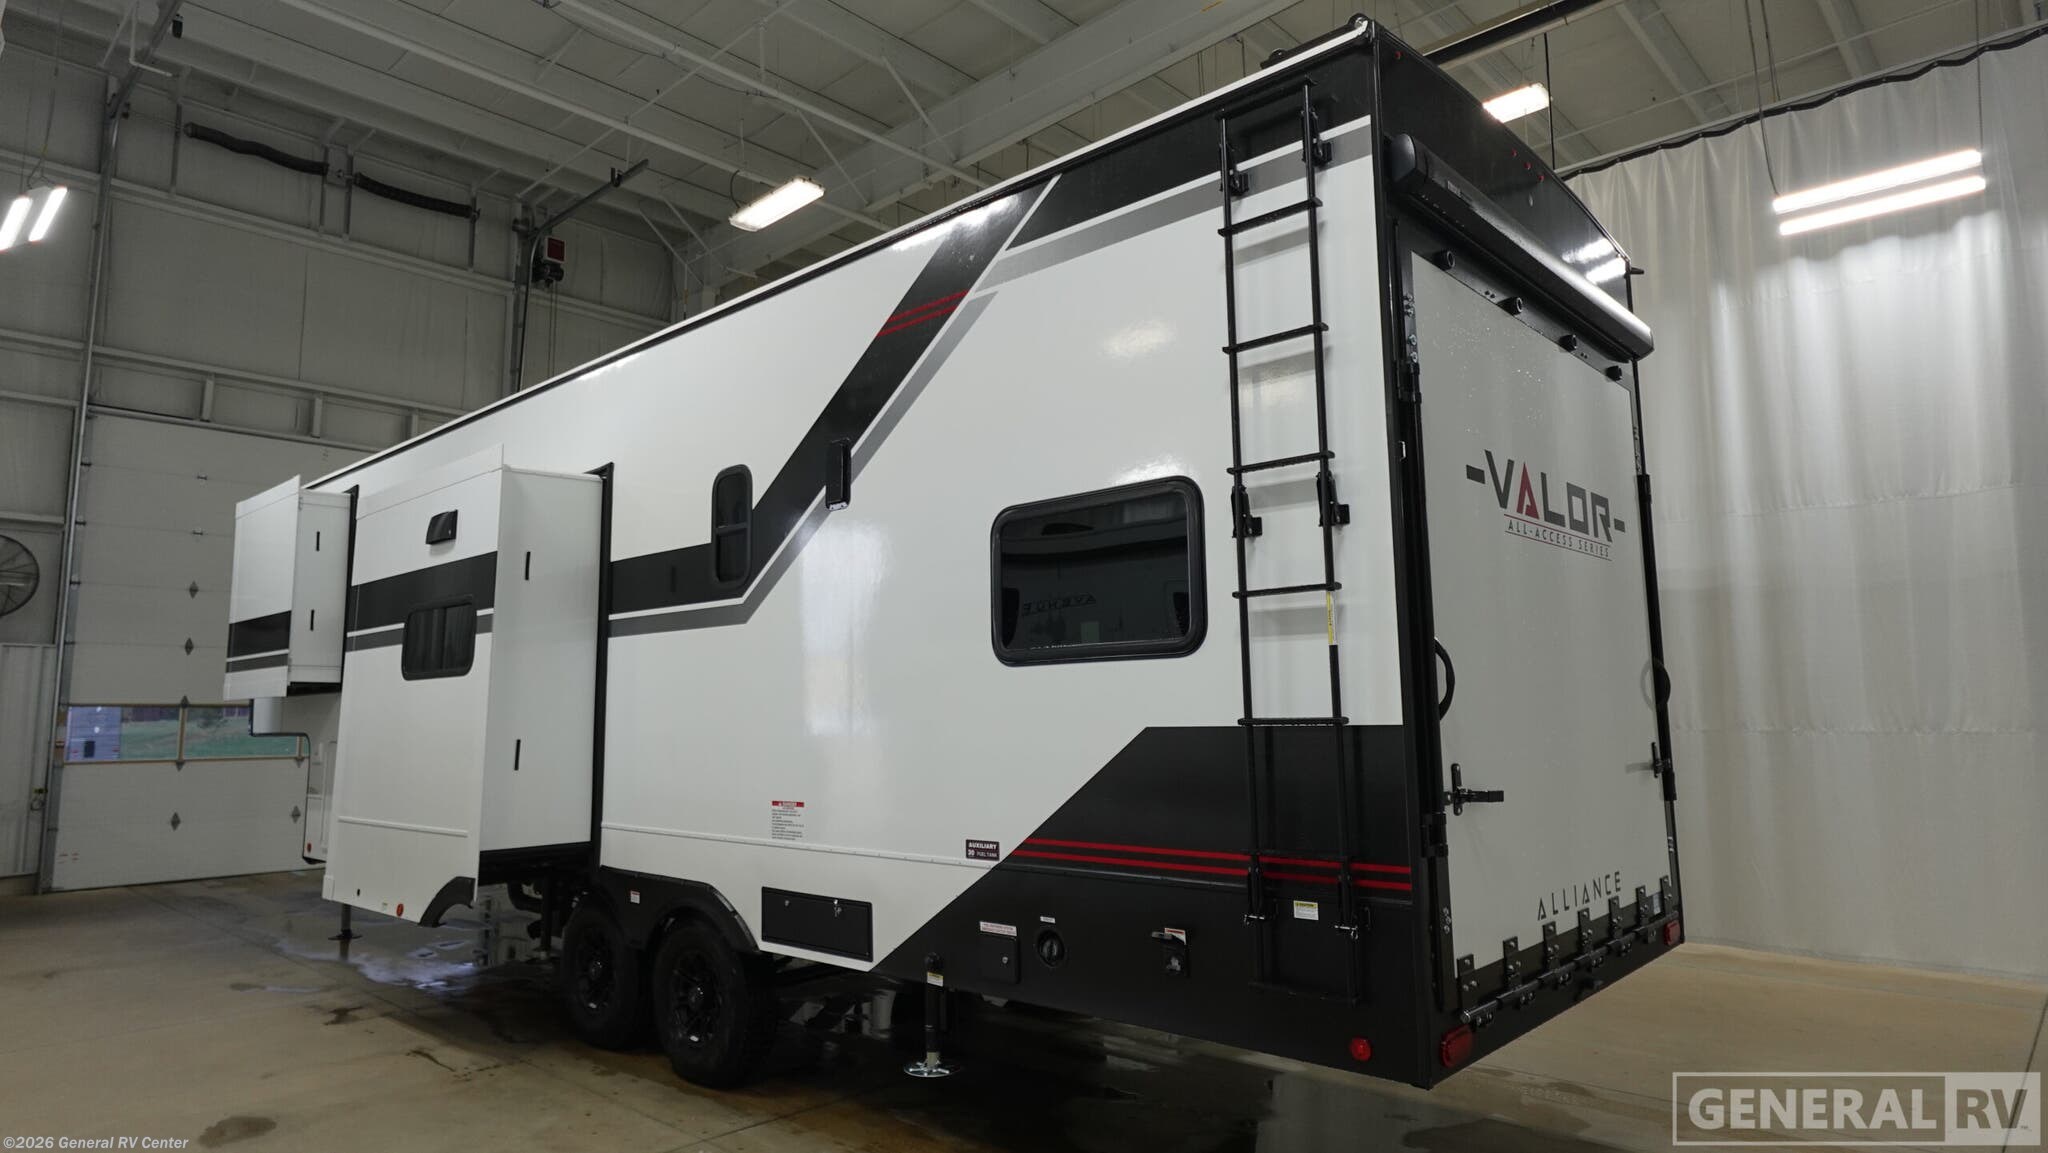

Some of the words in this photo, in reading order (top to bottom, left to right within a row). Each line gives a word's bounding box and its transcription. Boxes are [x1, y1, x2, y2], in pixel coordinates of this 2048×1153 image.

[1508, 519, 1573, 547] ALL-ACCESS
[1578, 539, 1609, 558] SERIES
[1537, 871, 1621, 920] ALLIANCE
